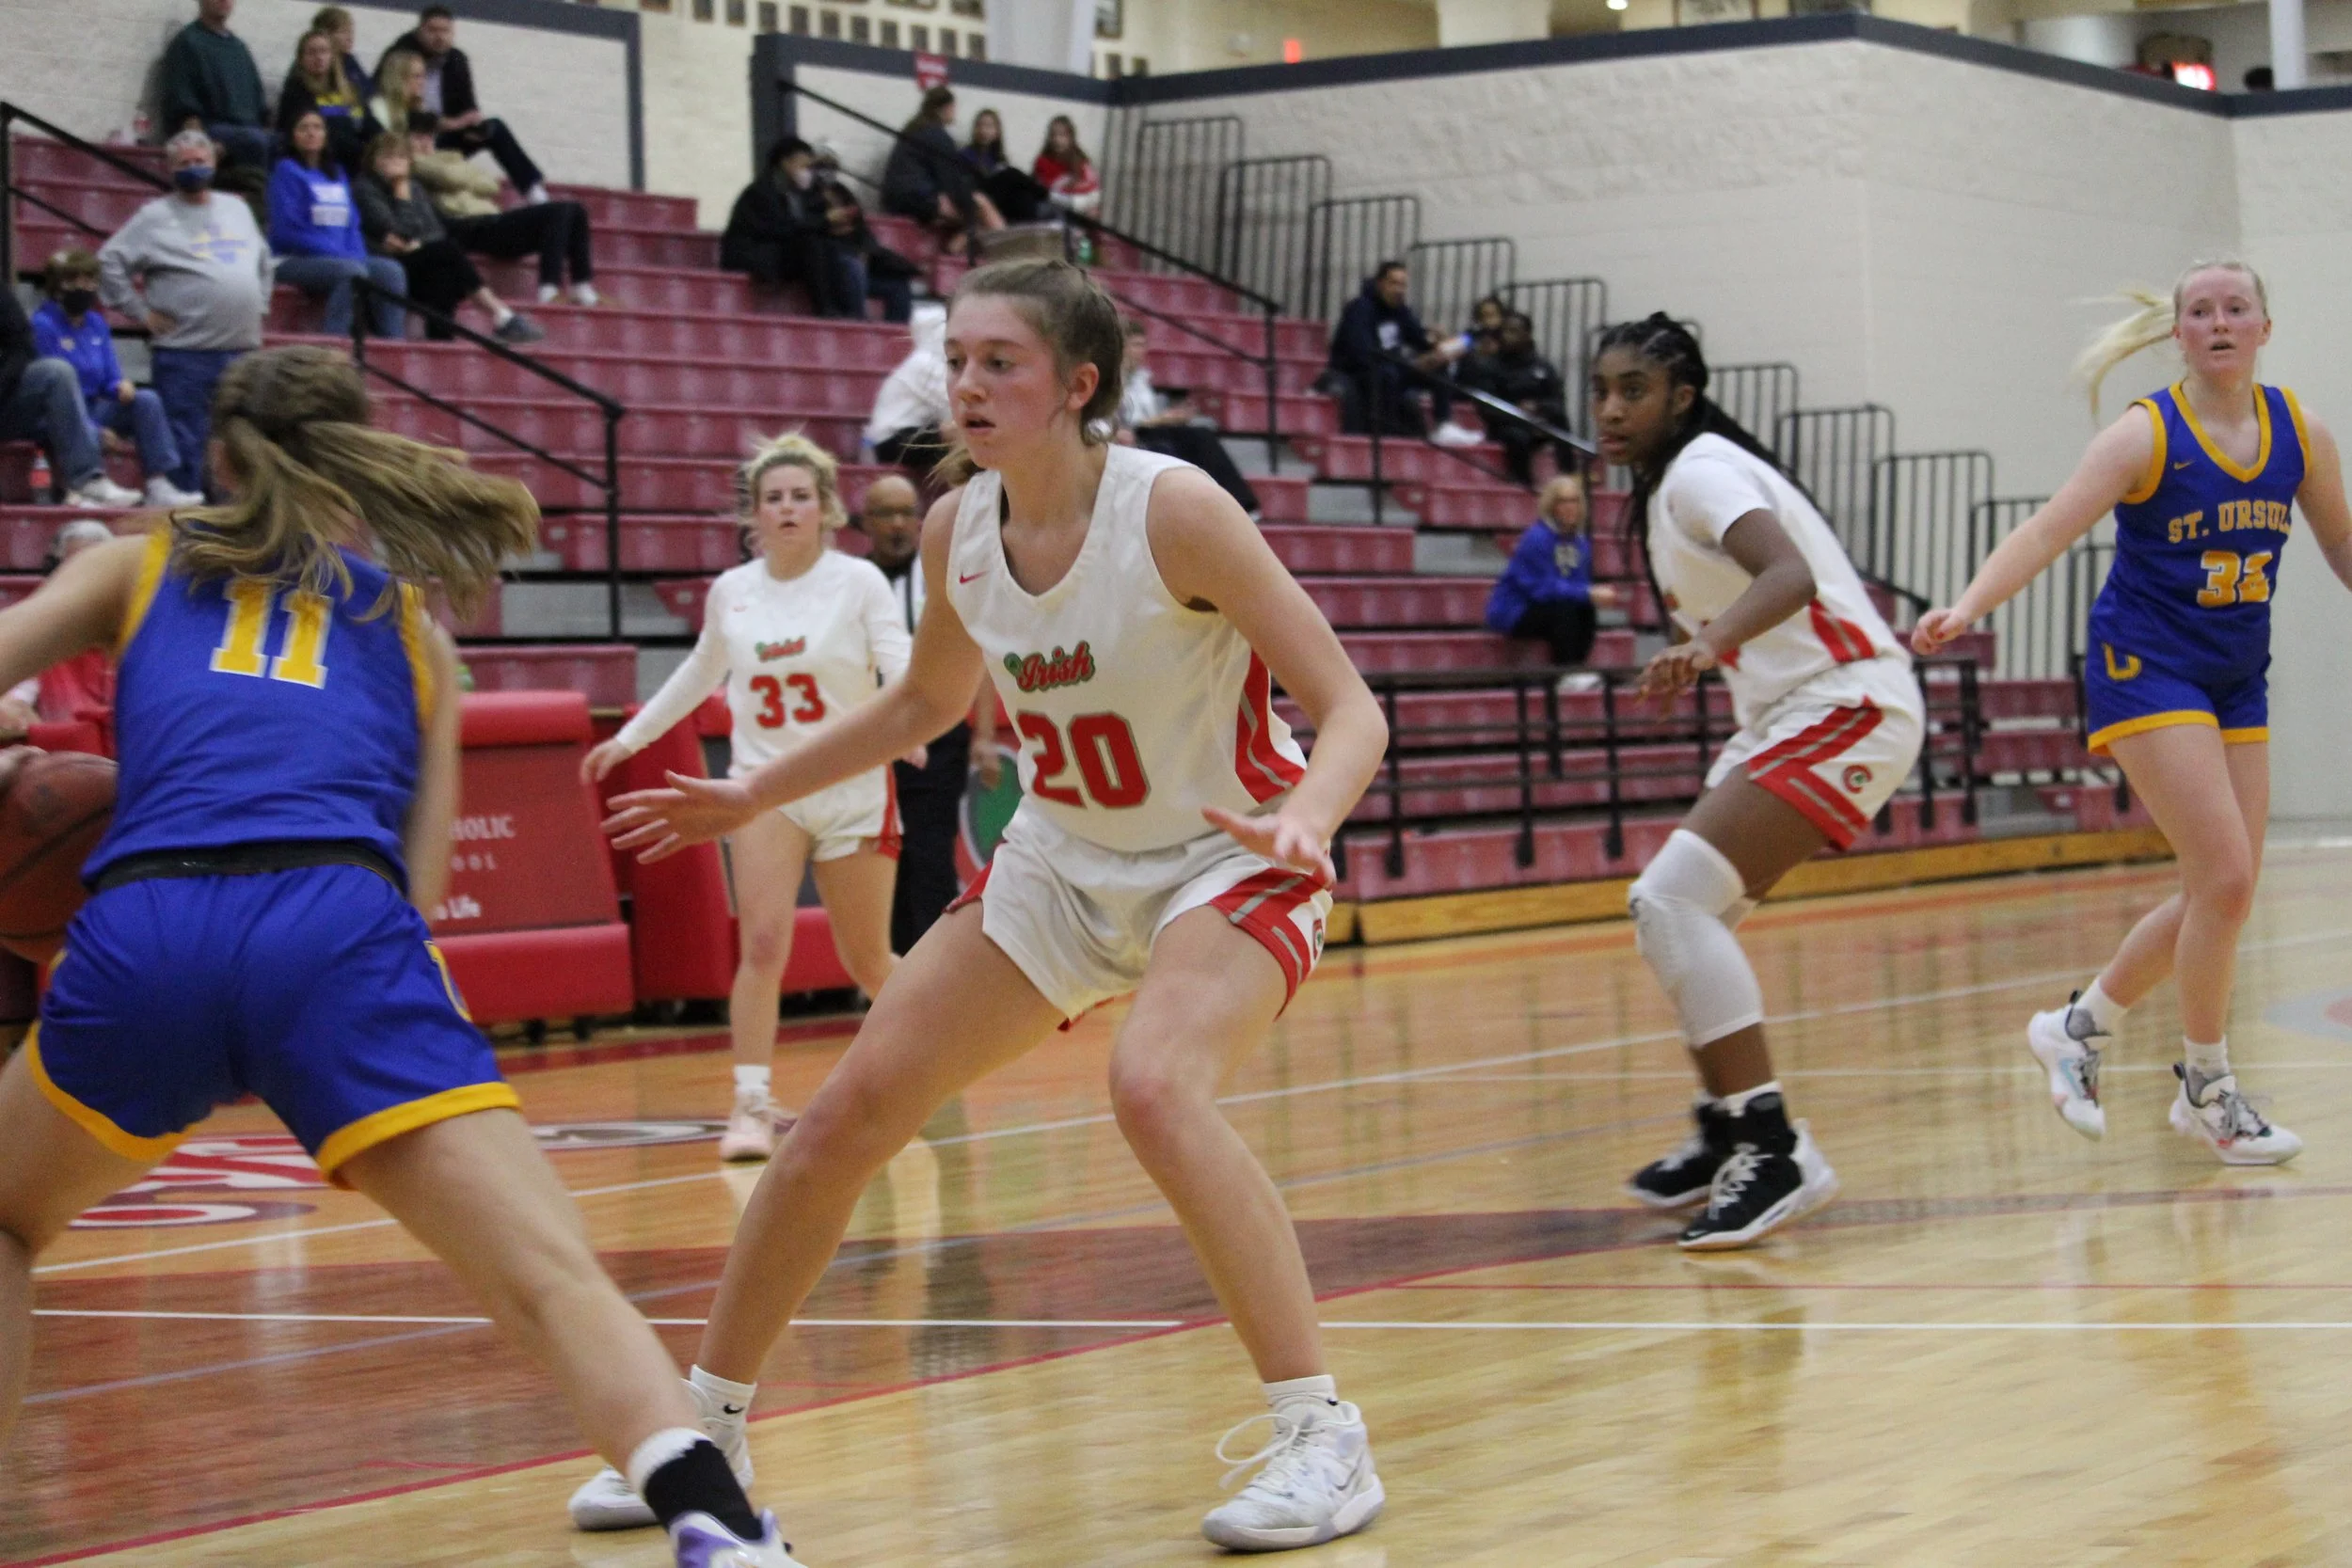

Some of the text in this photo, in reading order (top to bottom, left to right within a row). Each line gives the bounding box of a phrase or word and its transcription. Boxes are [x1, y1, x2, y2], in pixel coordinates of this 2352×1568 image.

[2168, 510, 2210, 544] ST.
[209, 576, 335, 689] 11
[1016, 640, 1096, 692] Irish
[749, 673, 826, 729] 33
[1016, 709, 1152, 810] 20
